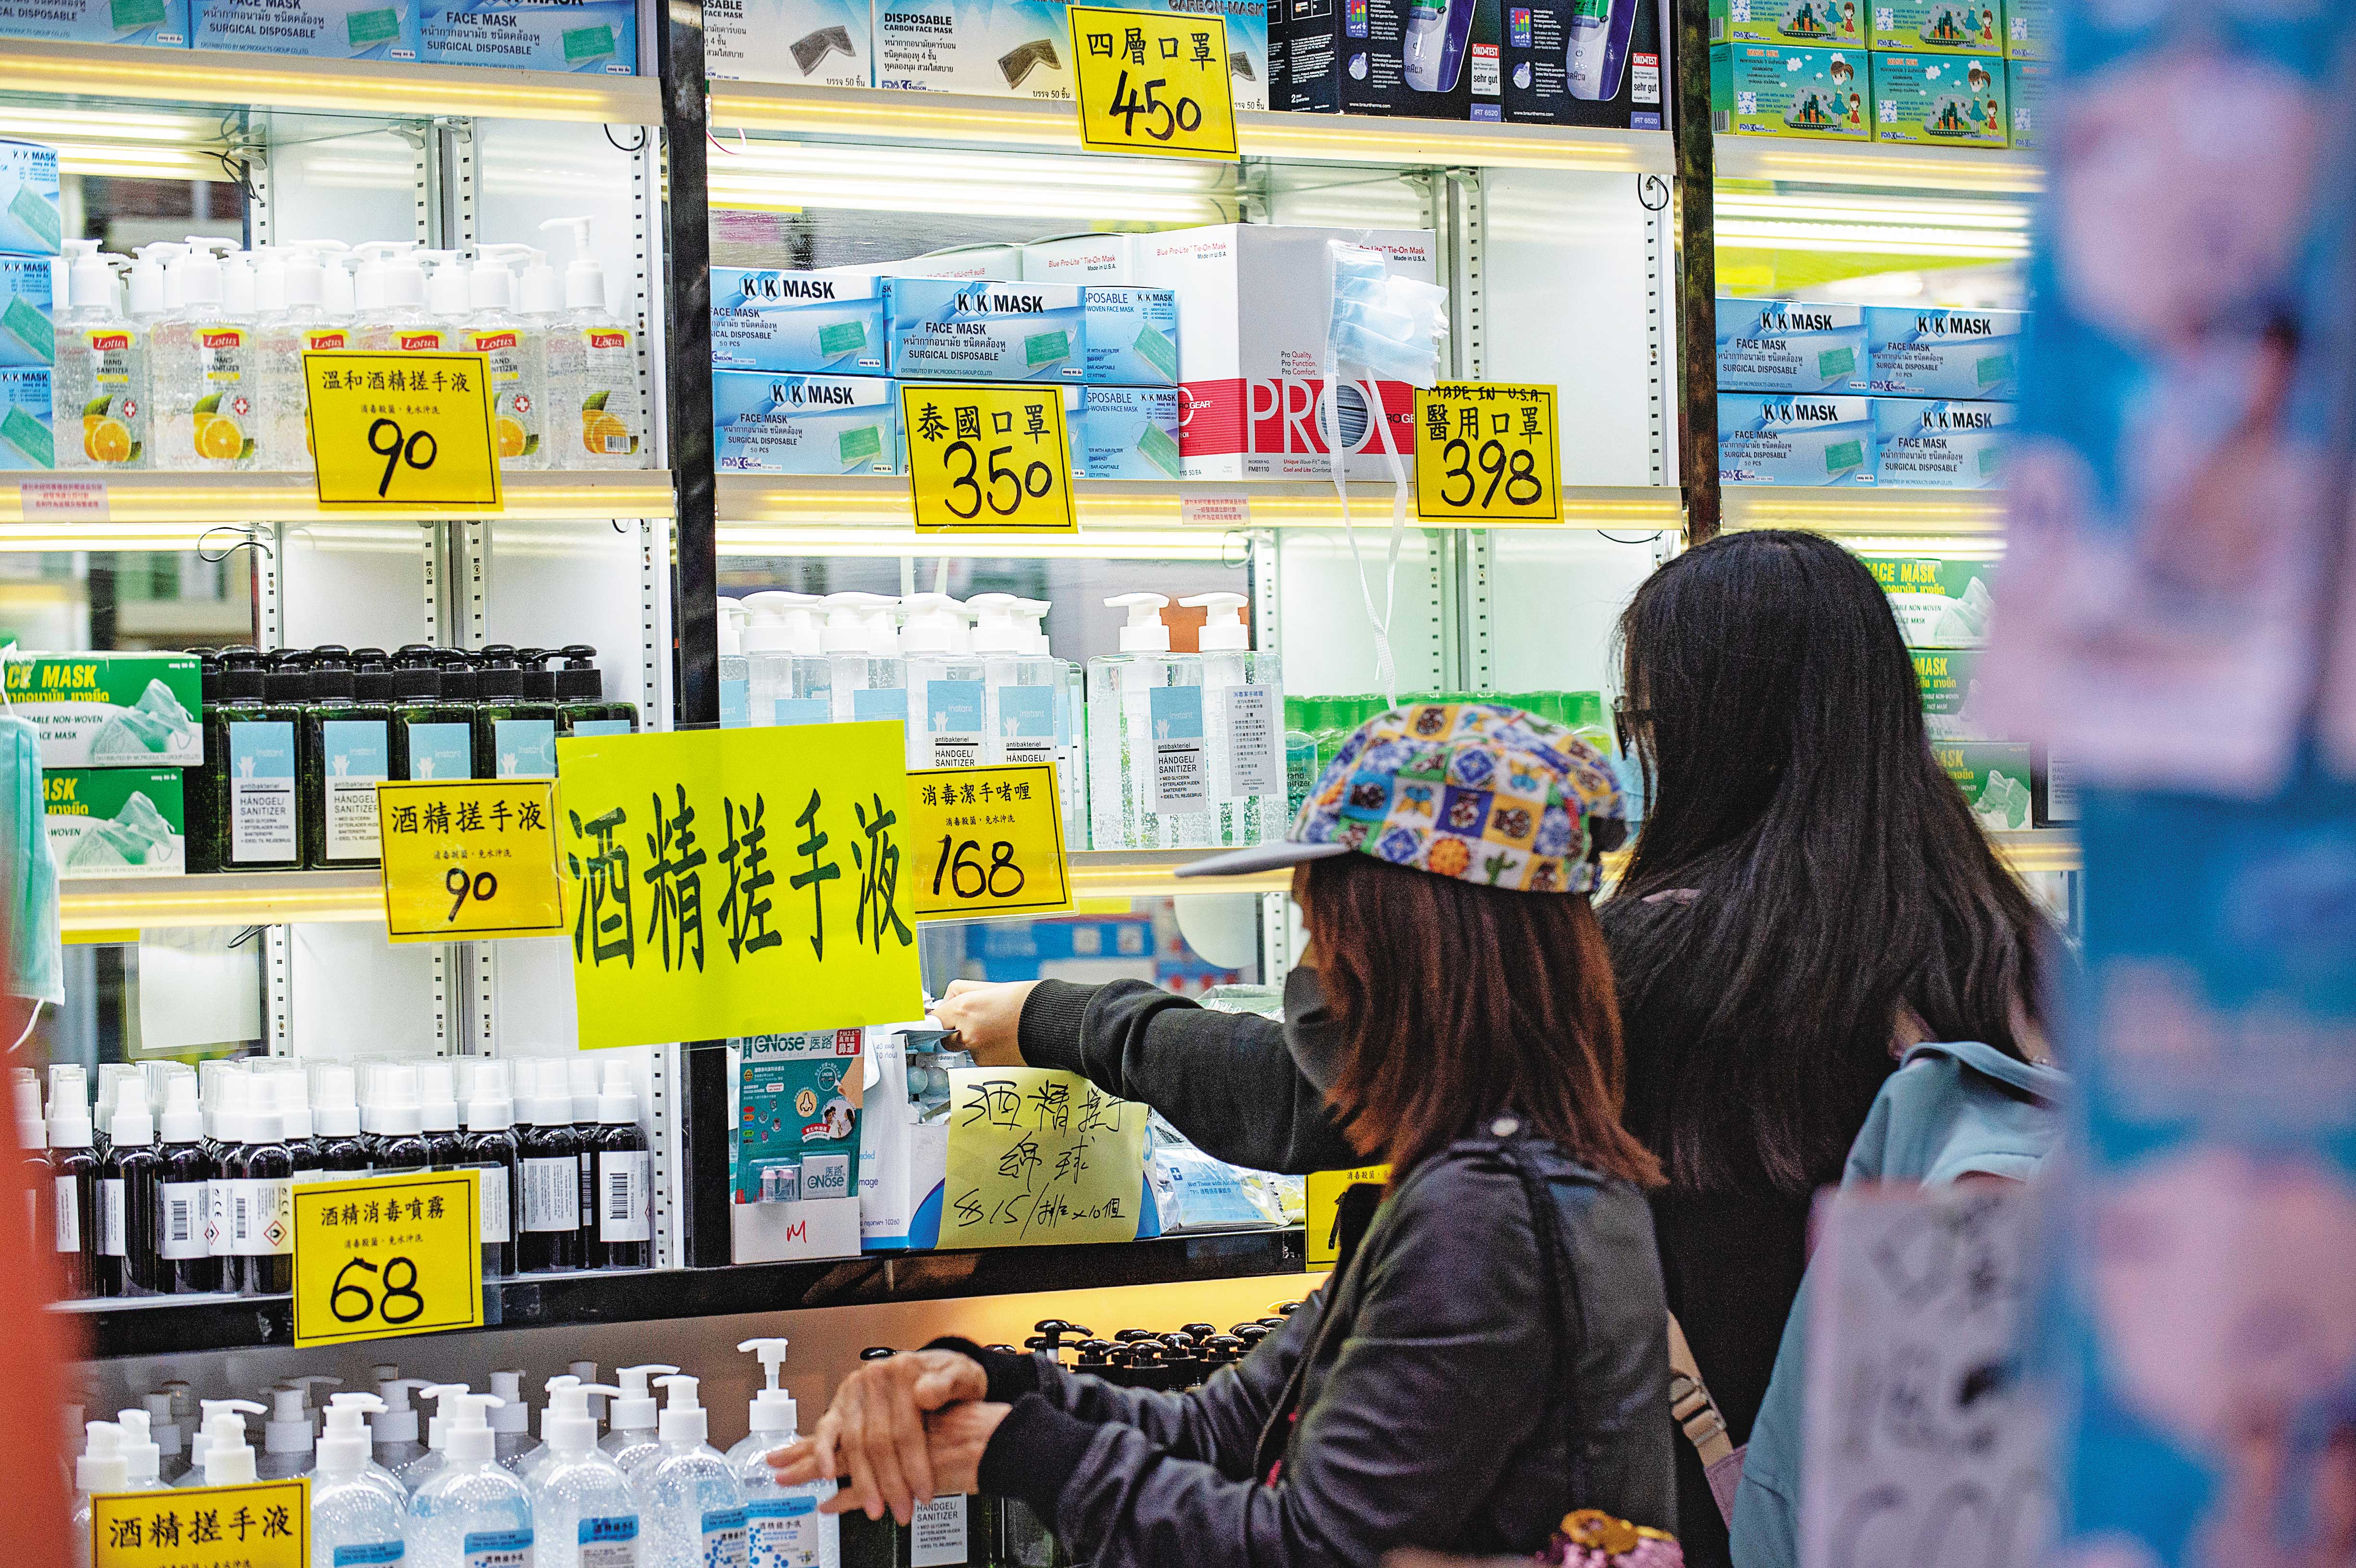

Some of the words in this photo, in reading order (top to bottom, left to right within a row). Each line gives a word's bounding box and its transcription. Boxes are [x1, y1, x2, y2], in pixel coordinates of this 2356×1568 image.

[447, 12, 477, 25] FACE
[483, 14, 516, 26] MASK
[885, 13, 952, 25] DISPOSABLE
[427, 41, 473, 52] SURGICAL
[476, 44, 532, 55] DISPOSABLE
[1086, 27, 1216, 71] 四層口罩
[1474, 74, 1487, 83] sehr
[1488, 75, 1497, 85] gut
[1648, 83, 1657, 93] gut
[1109, 70, 1201, 141] 450
[784, 280, 835, 299] MASK
[734, 308, 760, 317] MASK
[995, 296, 1044, 313] MASK
[926, 323, 952, 333] FACE
[957, 324, 985, 335] MASK
[1792, 314, 1832, 331] MASK
[1950, 318, 1991, 335] MASK
[97, 337, 125, 349] Lotus
[207, 336, 237, 346] Lotus
[405, 337, 436, 349] Lotus
[903, 335, 960, 347] หน้ากากอนามัย
[963, 336, 1005, 352] ชนิดคล้องหู
[1736, 339, 1758, 349] FACE
[1888, 342, 1907, 350] FACE
[909, 350, 948, 359] SURGICAL
[951, 352, 998, 361] DISPOSABLE
[1758, 365, 1797, 374] DISPOSABLE
[322, 369, 471, 392] 溫和酒精搓手液
[809, 386, 854, 405] MASK
[1428, 386, 1471, 400] MADE
[1479, 387, 1495, 400] IN
[741, 413, 761, 423] FACE
[765, 414, 787, 423] MASK
[1796, 405, 1838, 421] MASK
[917, 402, 1050, 444] 泰國口罩
[1426, 404, 1543, 445] 醫用口罩
[1899, 438, 1920, 448] FACE
[368, 418, 437, 498] 90
[944, 441, 1052, 518] 350
[1441, 438, 1542, 509] 398
[42, 665, 97, 688] MASK
[1159, 765, 1197, 773] SANITIZER
[922, 782, 1032, 806] 消毒潔手啫喱
[241, 807, 286, 815] SANITIZER
[392, 801, 546, 834] 酒精搓手液
[933, 834, 1024, 897] 168
[569, 783, 912, 973] 酒精搓手液
[446, 867, 497, 922] 90
[322, 1196, 445, 1226] 酒精消毒噴霧
[787, 1220, 806, 1243] M
[331, 1257, 424, 1324] 68
[918, 1512, 958, 1522] SANITIZER
[109, 1506, 293, 1548] 酒精搓手液
